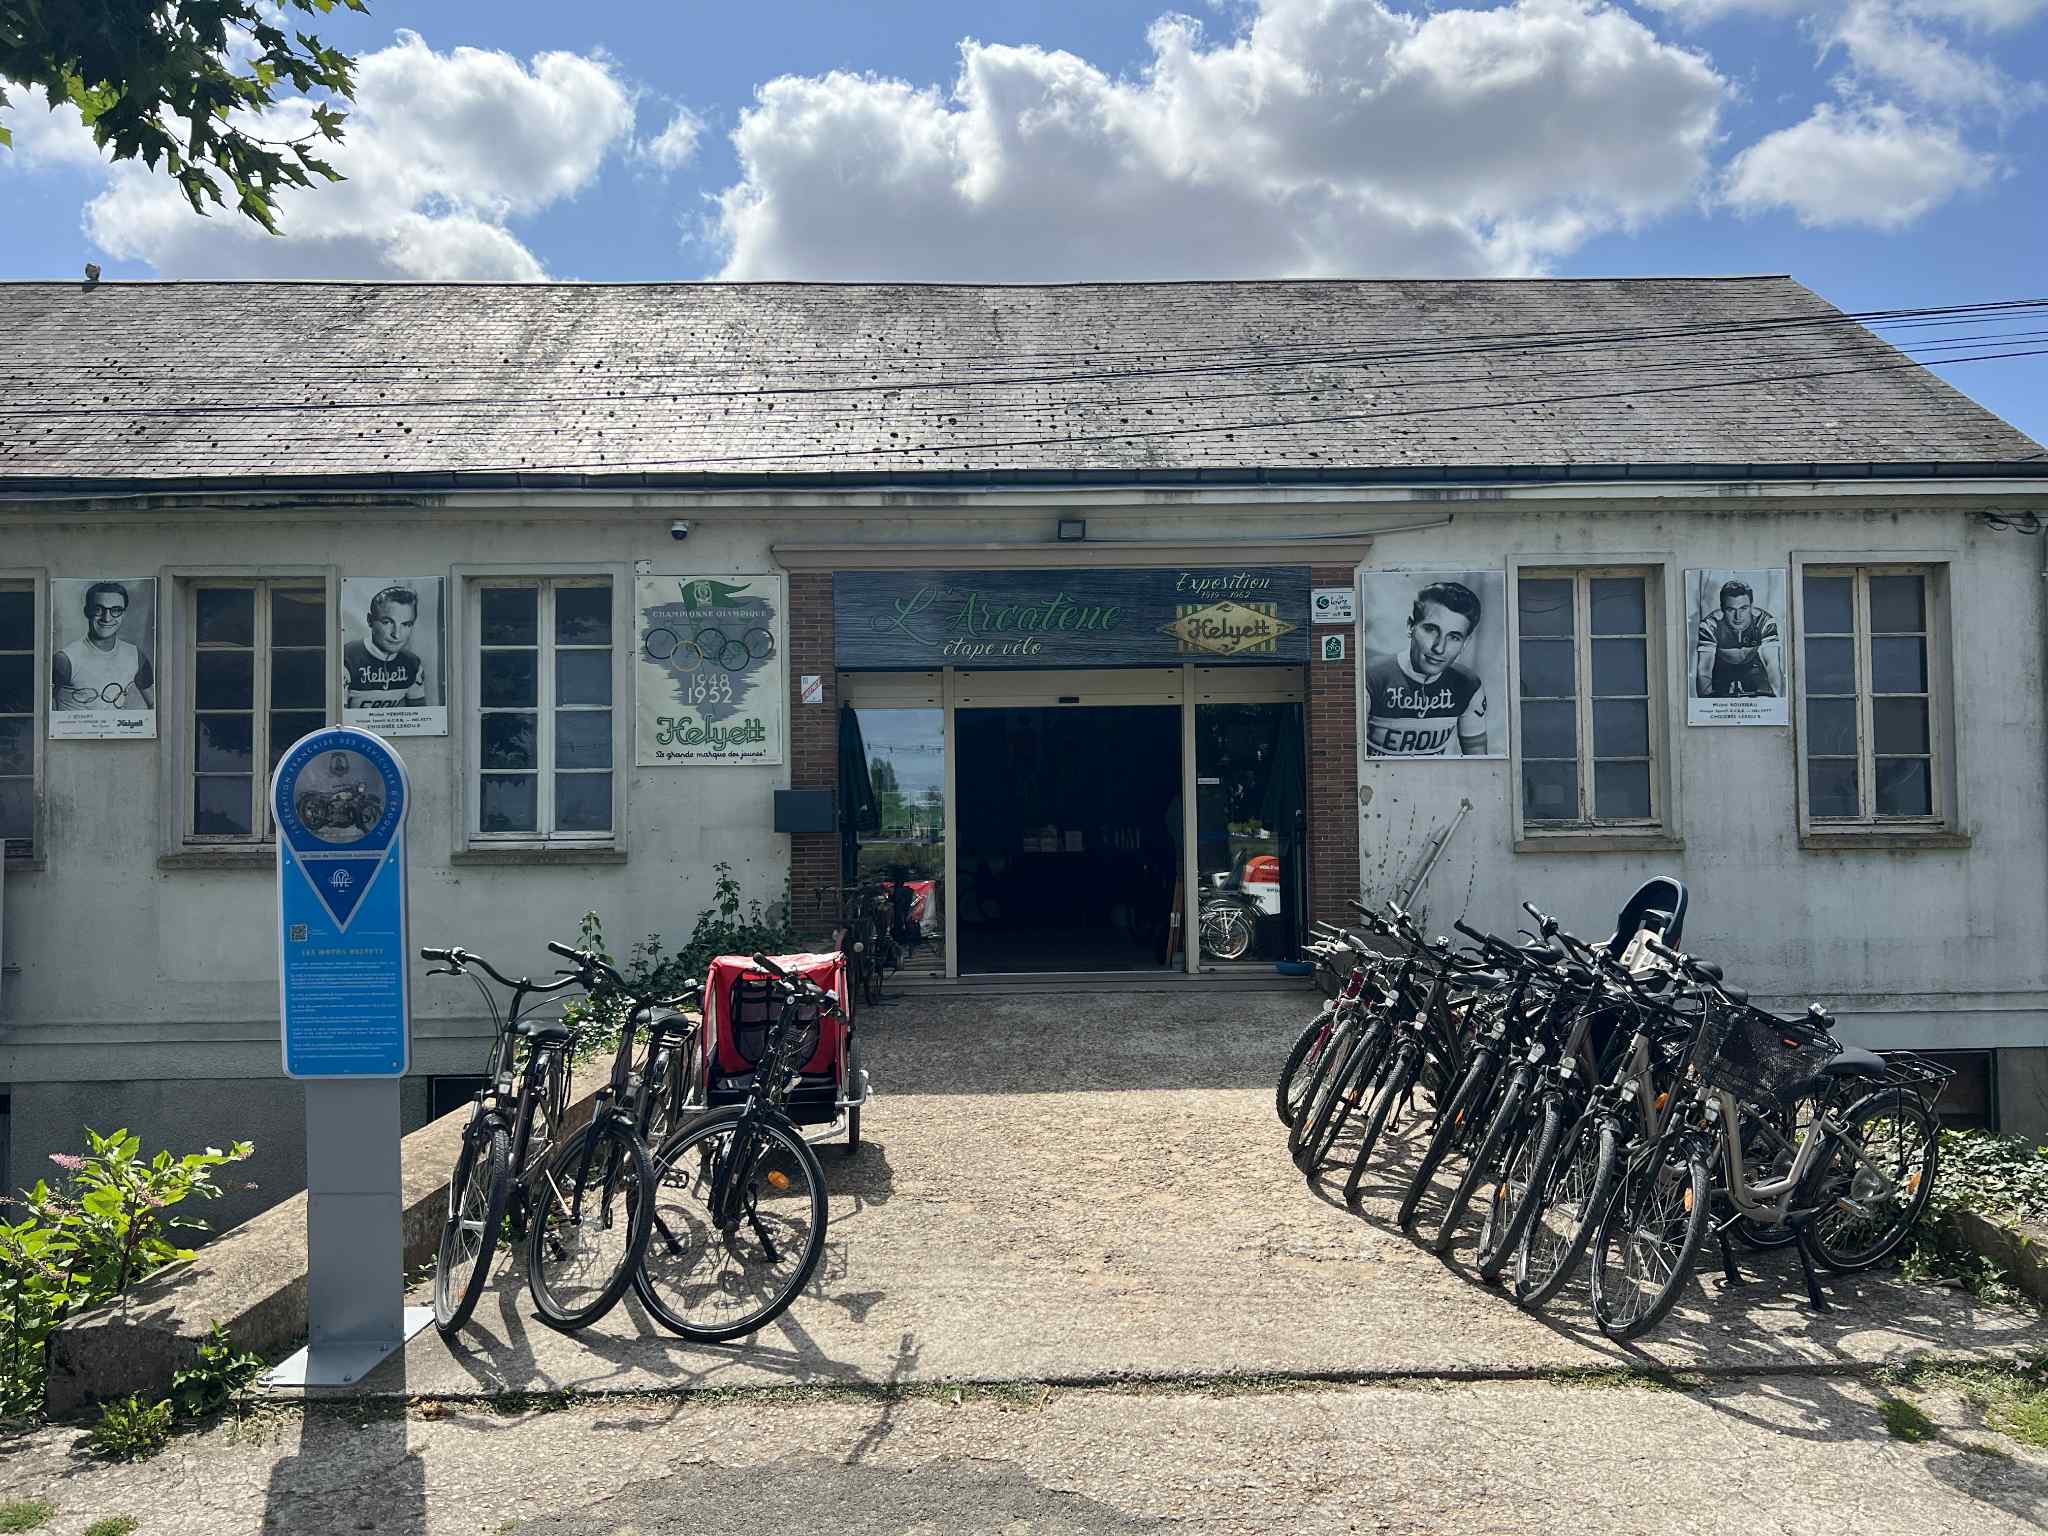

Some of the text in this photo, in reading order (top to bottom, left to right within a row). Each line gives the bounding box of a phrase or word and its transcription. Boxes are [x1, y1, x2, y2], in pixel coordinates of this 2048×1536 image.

[1176, 572, 1272, 594] Exposition
[1187, 617, 1271, 645] Helyett
[1002, 636, 1042, 657] vélo
[358, 665, 408, 690] Helyett
[691, 673, 730, 689] 1948
[688, 687, 733, 704] 1952
[1386, 686, 1456, 719] Helyett
[656, 714, 766, 751] Helyett
[666, 750, 695, 761] grande
[696, 750, 727, 760] marque
